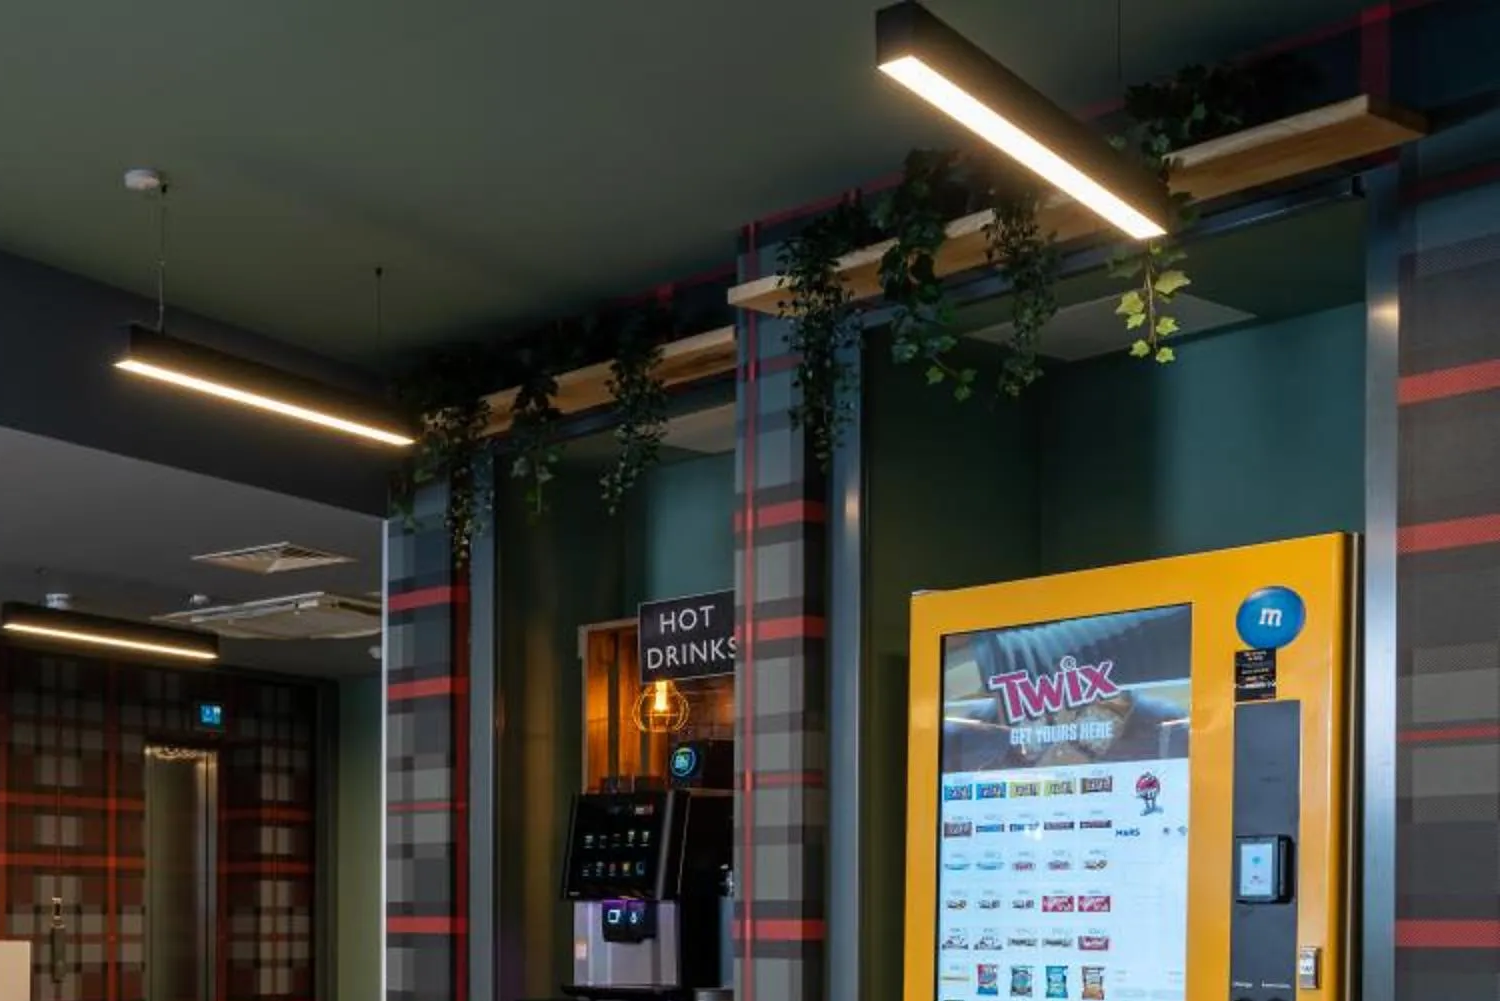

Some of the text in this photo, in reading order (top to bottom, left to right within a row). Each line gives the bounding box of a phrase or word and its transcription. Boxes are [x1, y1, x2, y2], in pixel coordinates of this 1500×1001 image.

[660, 605, 715, 634] HOT
[1259, 608, 1282, 627] m
[647, 636, 737, 669] DRINKS
[1011, 721, 1113, 744] GET YOURS HERE
